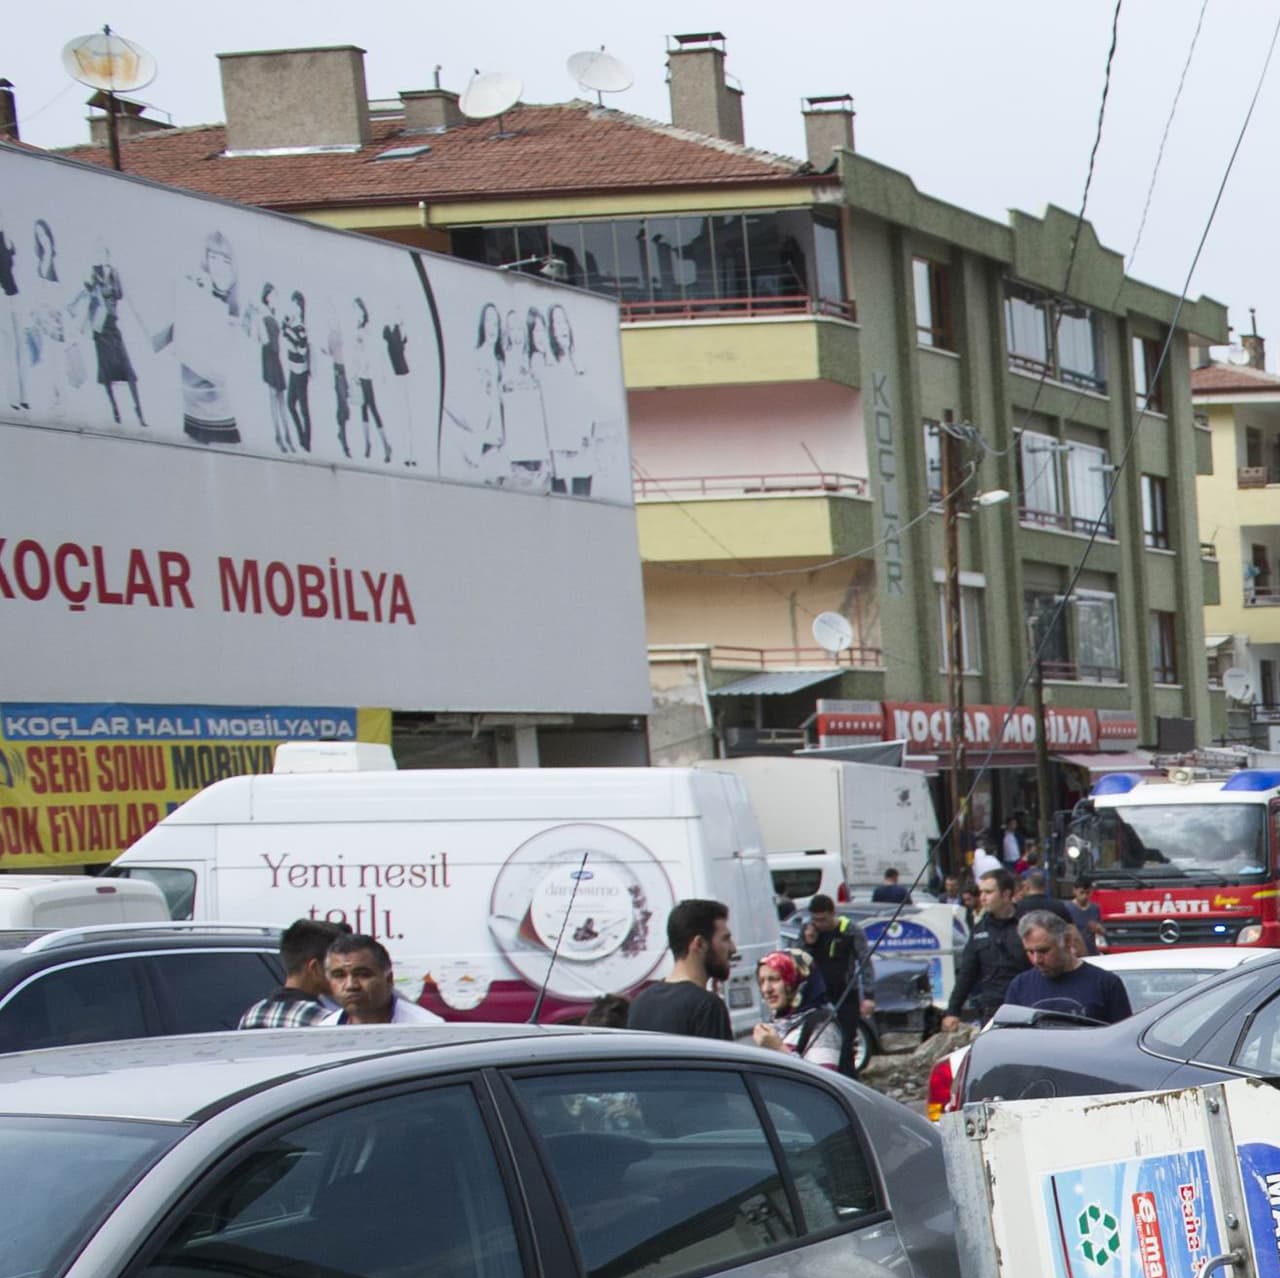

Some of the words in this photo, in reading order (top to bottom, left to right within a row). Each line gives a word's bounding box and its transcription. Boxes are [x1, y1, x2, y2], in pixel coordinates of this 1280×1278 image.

[218, 557, 416, 625] MOBİLYA
[6, 717, 130, 739] KOÇLAR
[136, 717, 202, 736] HALI
[207, 714, 354, 737] MOBİLYA'DA
[95, 745, 167, 793] SONU
[261, 852, 346, 889] Yeni
[358, 852, 451, 889] nesil
